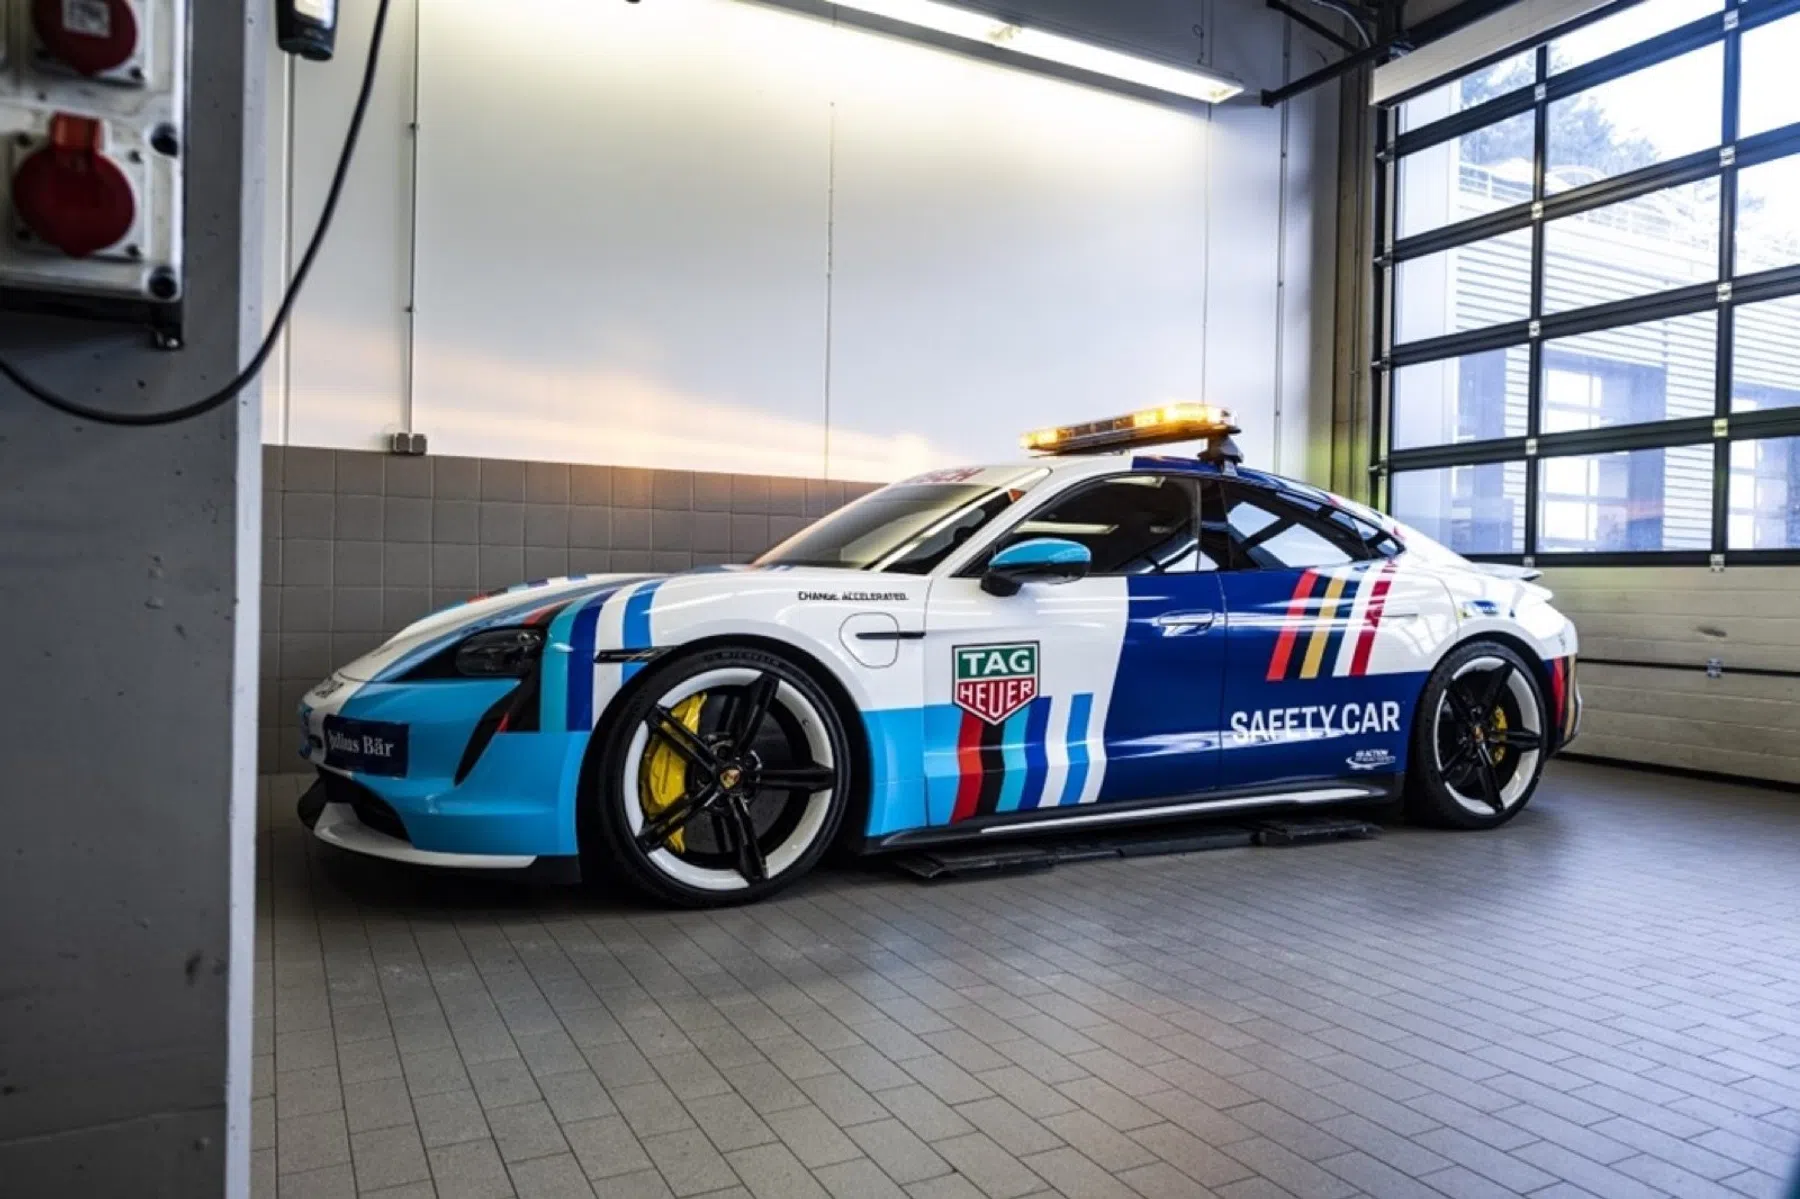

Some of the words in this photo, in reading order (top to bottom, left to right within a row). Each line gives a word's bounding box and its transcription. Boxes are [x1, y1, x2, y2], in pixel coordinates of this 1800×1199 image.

[961, 649, 1031, 676] TAG
[959, 680, 1032, 718] HEUER
[1230, 704, 1338, 744] SAFETY
[1341, 701, 1400, 735] CAR
[363, 735, 394, 758] Bär
